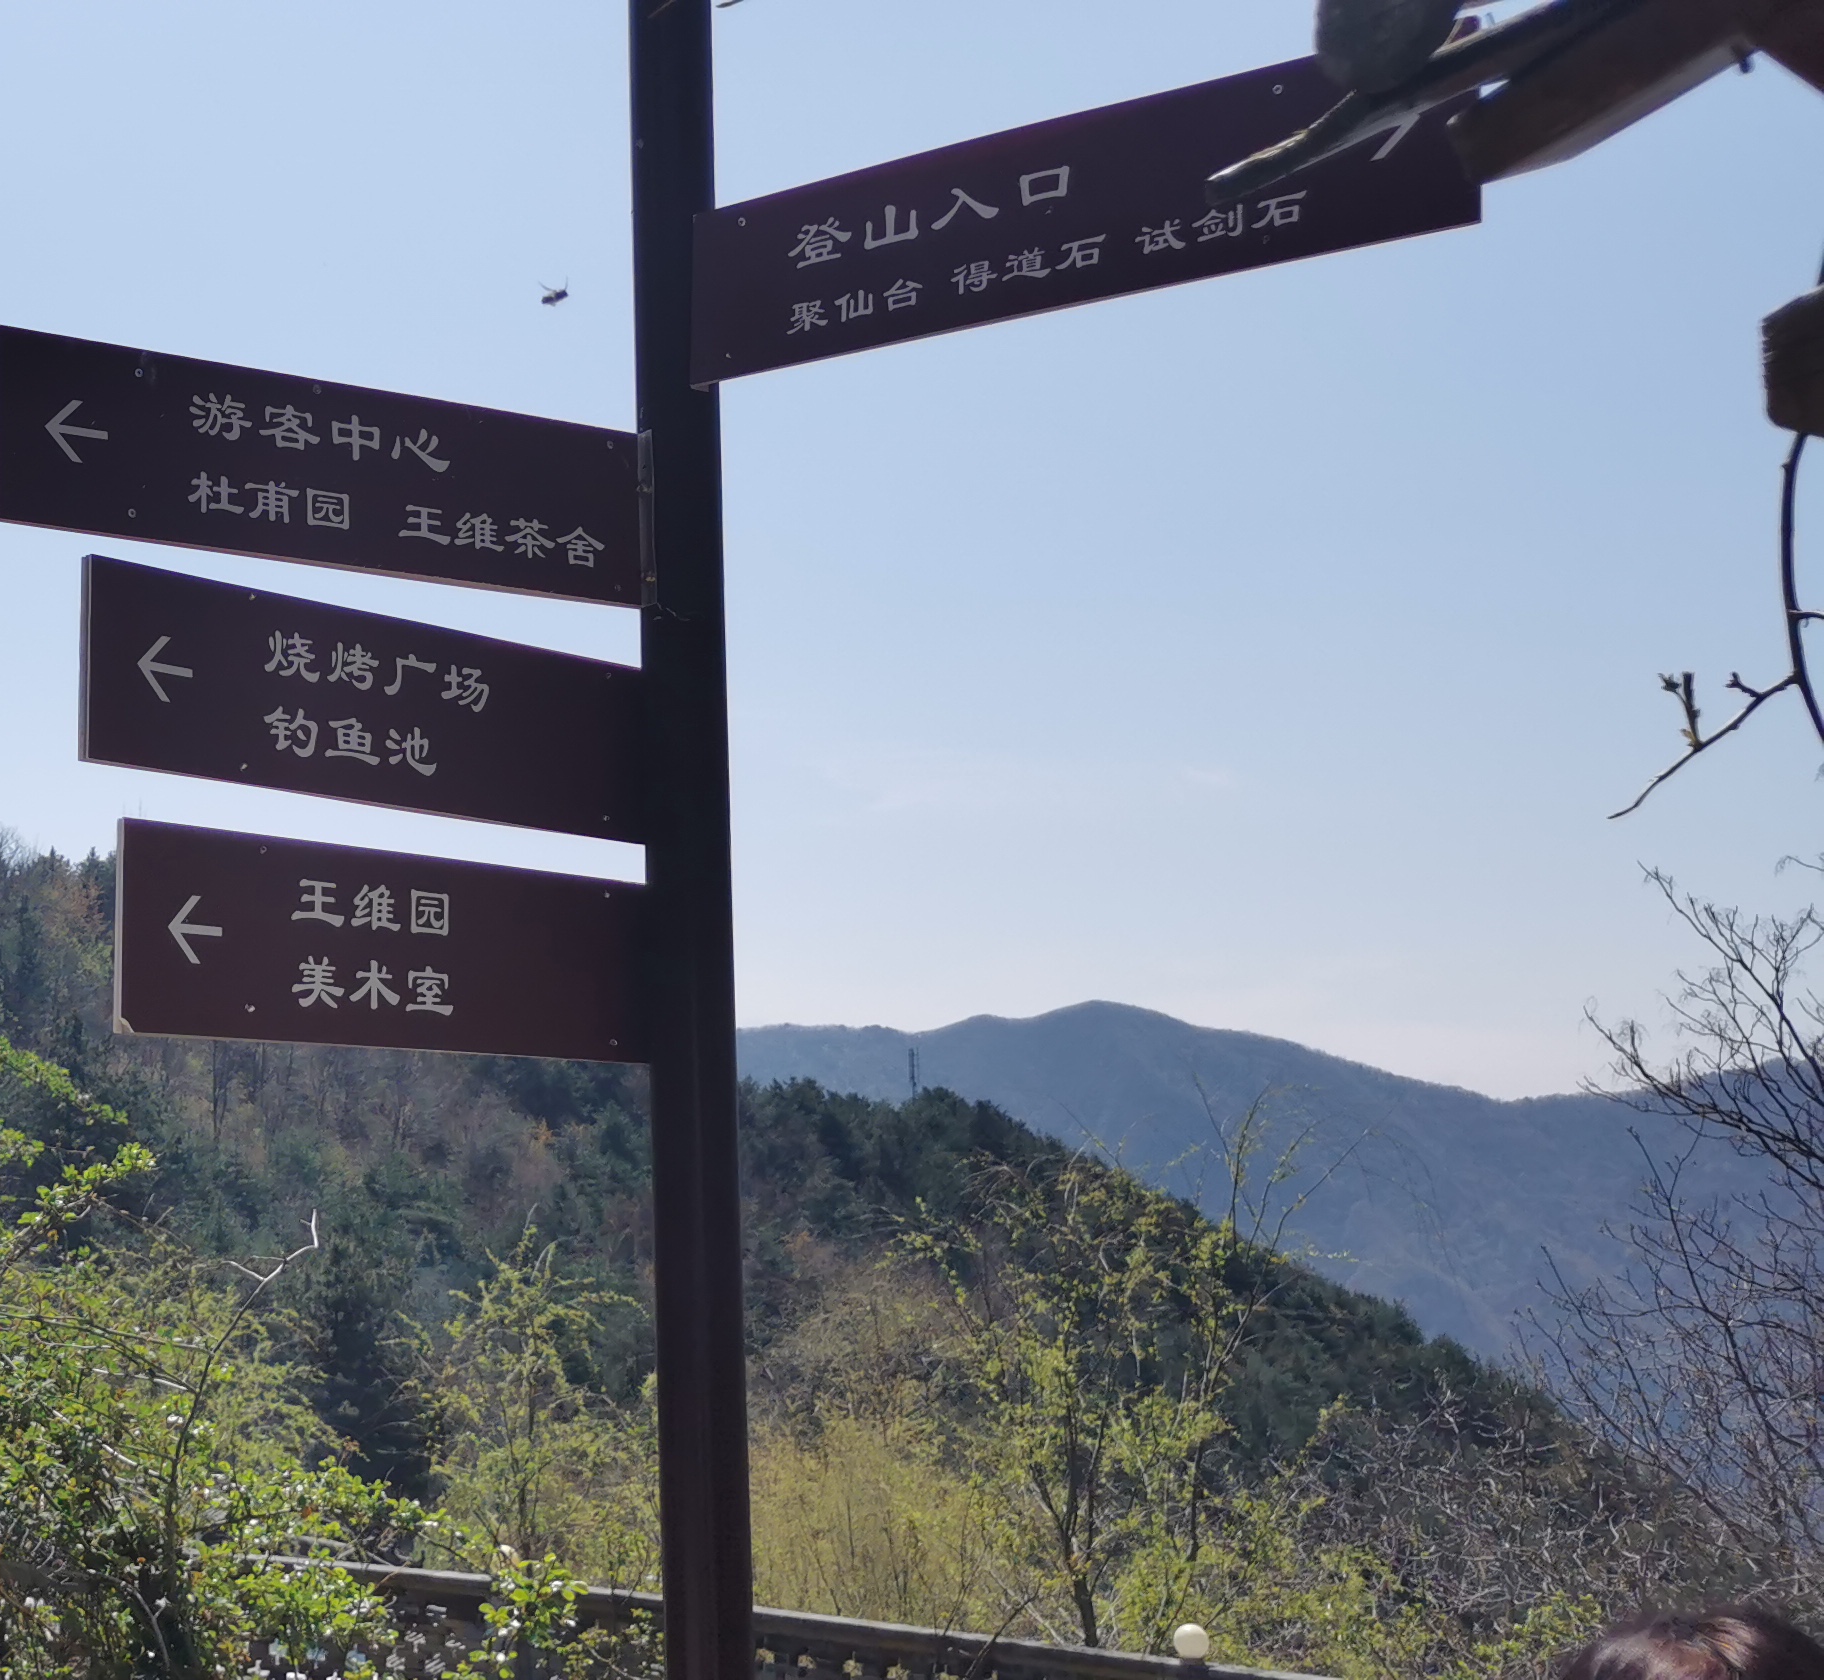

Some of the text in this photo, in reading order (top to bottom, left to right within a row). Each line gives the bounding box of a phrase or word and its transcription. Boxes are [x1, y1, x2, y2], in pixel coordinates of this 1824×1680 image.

[788, 166, 1069, 268] 登山入口
[788, 190, 1307, 334] 聚仙台 得道石 试剑石
[189, 393, 450, 472] 游客中心
[188, 471, 604, 567] 杜甫园 王维茶舍
[264, 631, 489, 712] 烧烤广场
[263, 706, 436, 776] 钓鱼池
[291, 879, 450, 936] 王维园
[291, 956, 454, 1016] 美术室
